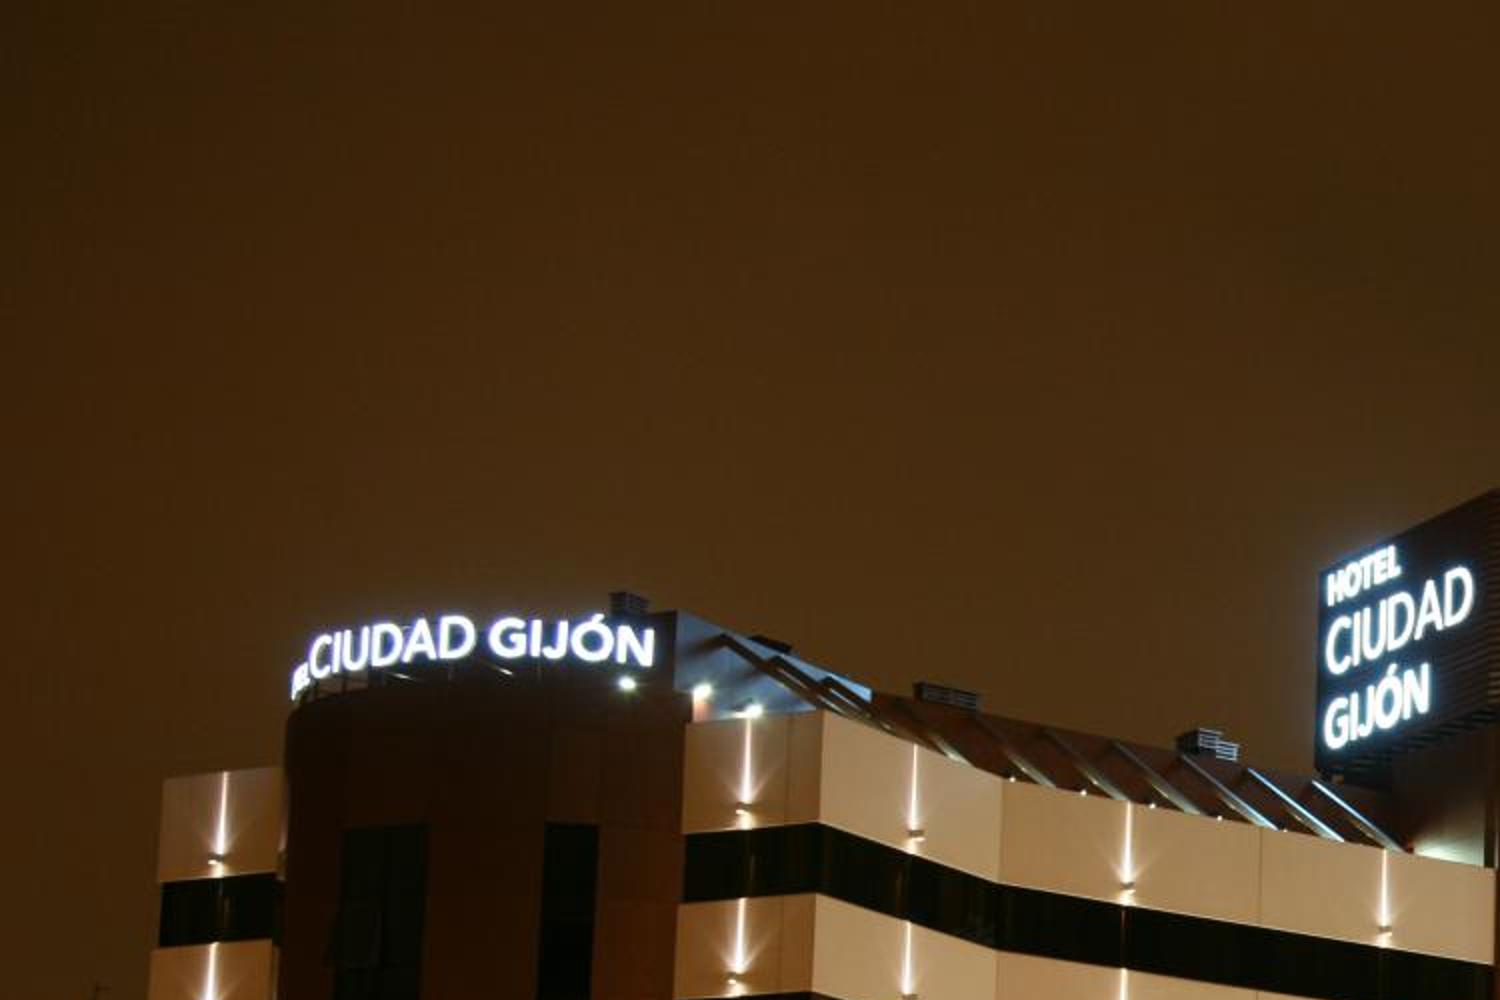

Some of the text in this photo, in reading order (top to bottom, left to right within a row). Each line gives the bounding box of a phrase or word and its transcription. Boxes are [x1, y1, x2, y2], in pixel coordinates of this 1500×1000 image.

[1327, 545, 1401, 606] HOTEL
[310, 614, 654, 679] CIUDAD GIJÓN
[1326, 567, 1473, 674] CIUDAD
[1324, 663, 1429, 749] GIJÓN
